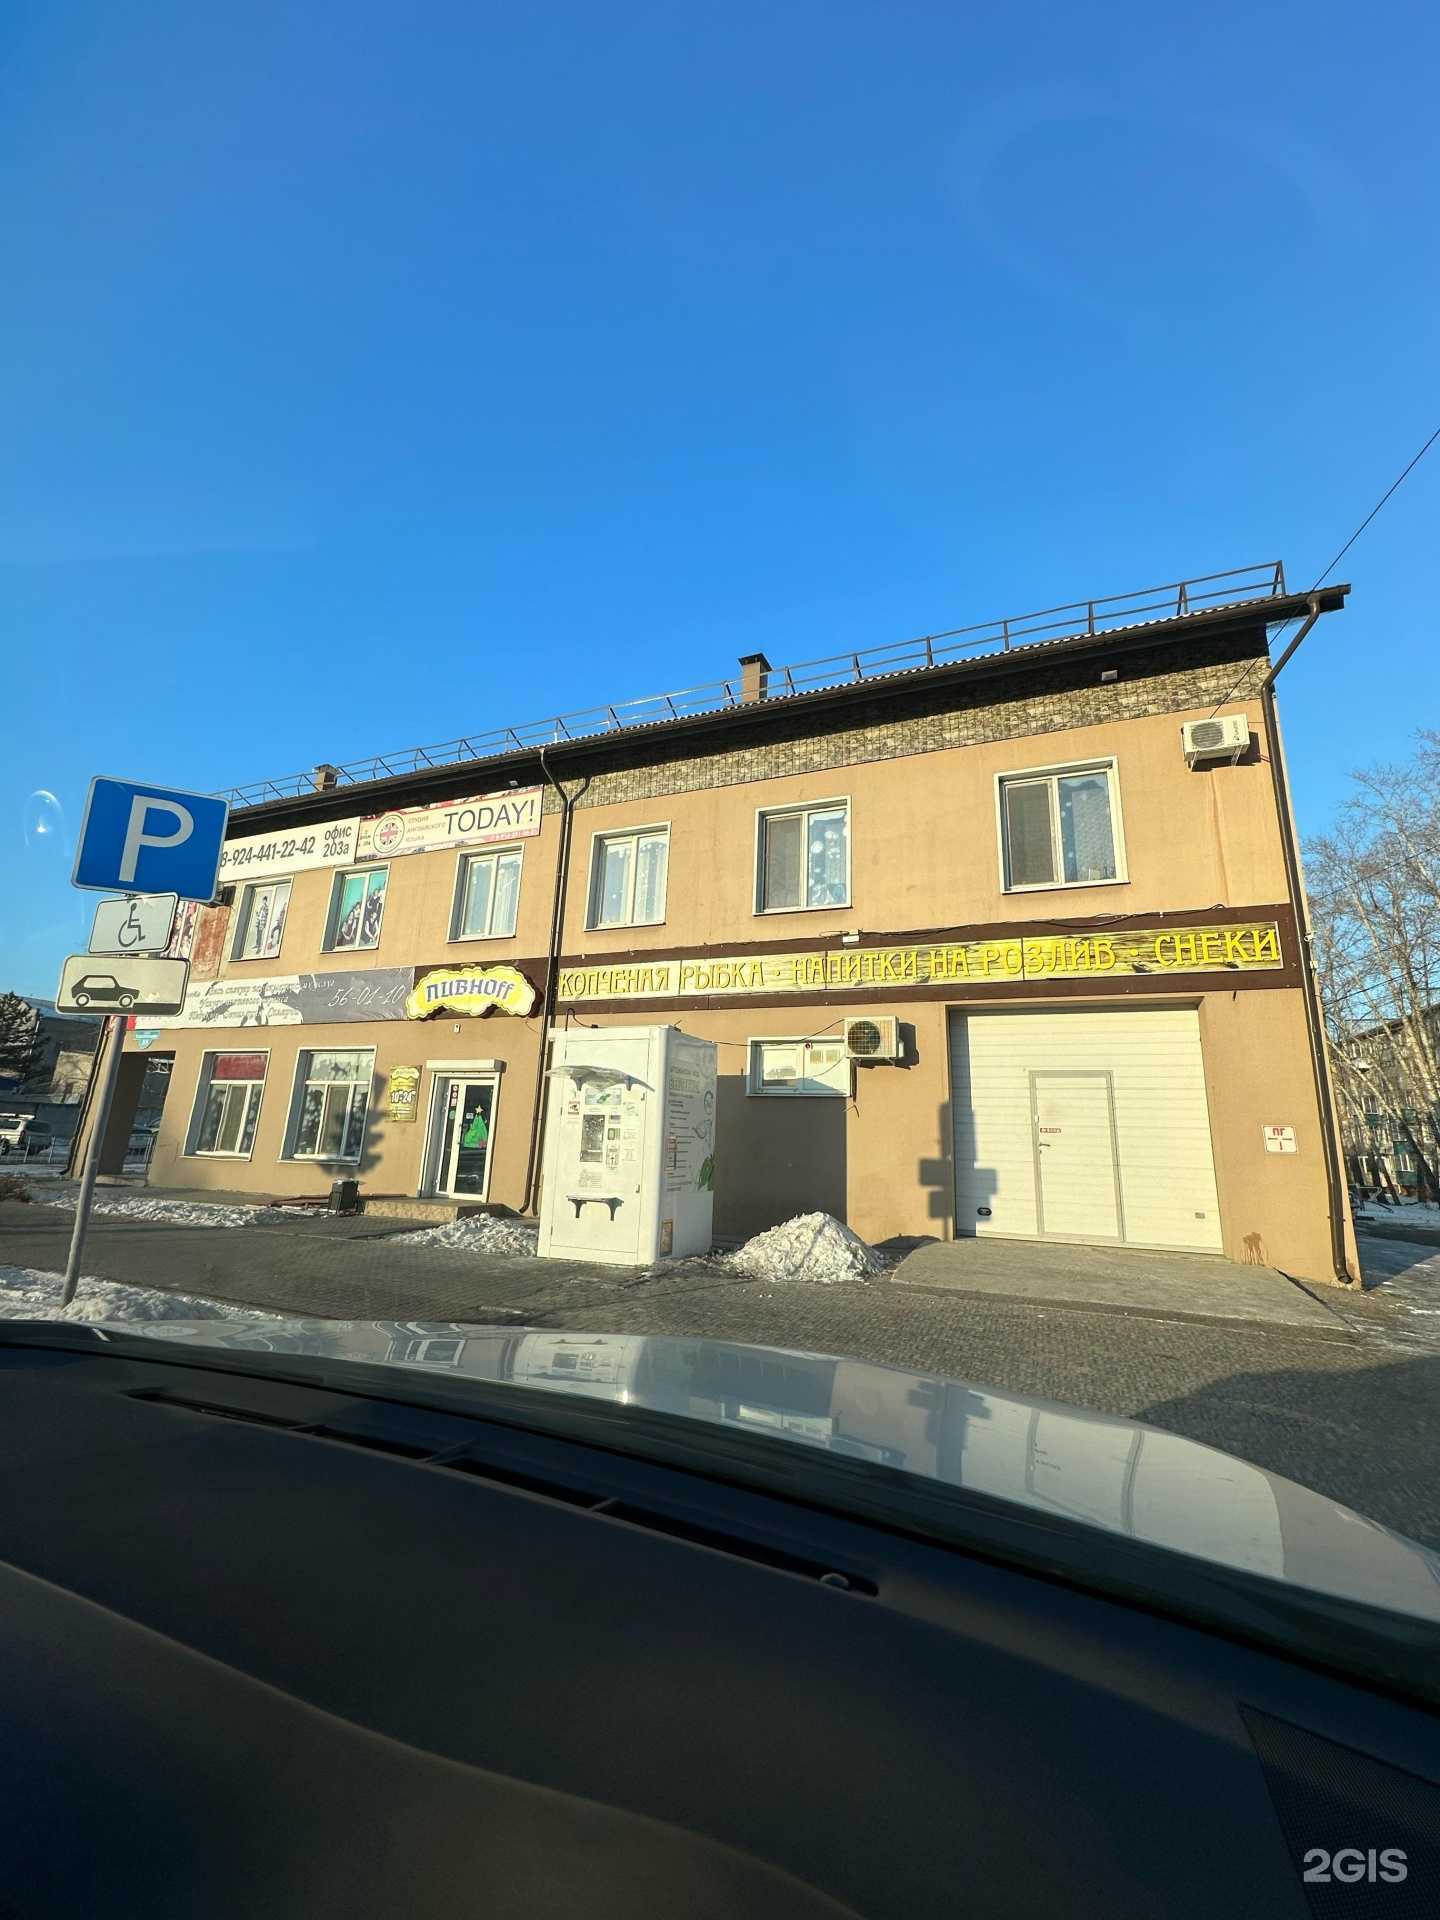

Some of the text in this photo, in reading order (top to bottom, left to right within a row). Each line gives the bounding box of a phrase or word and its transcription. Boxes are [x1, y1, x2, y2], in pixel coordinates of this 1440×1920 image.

[324, 823, 352, 843] офис
[444, 799, 535, 835] TODAY!
[118, 794, 194, 882] P
[220, 836, 316, 868] 8-924-441-22-42
[323, 841, 350, 858] 203а
[559, 928, 1281, 997] КОПЧЕНАЯ РЫБКА НАПИТКИ НА РОЗЛИВ СНЕКИ
[328, 984, 406, 1007] 56-01-10
